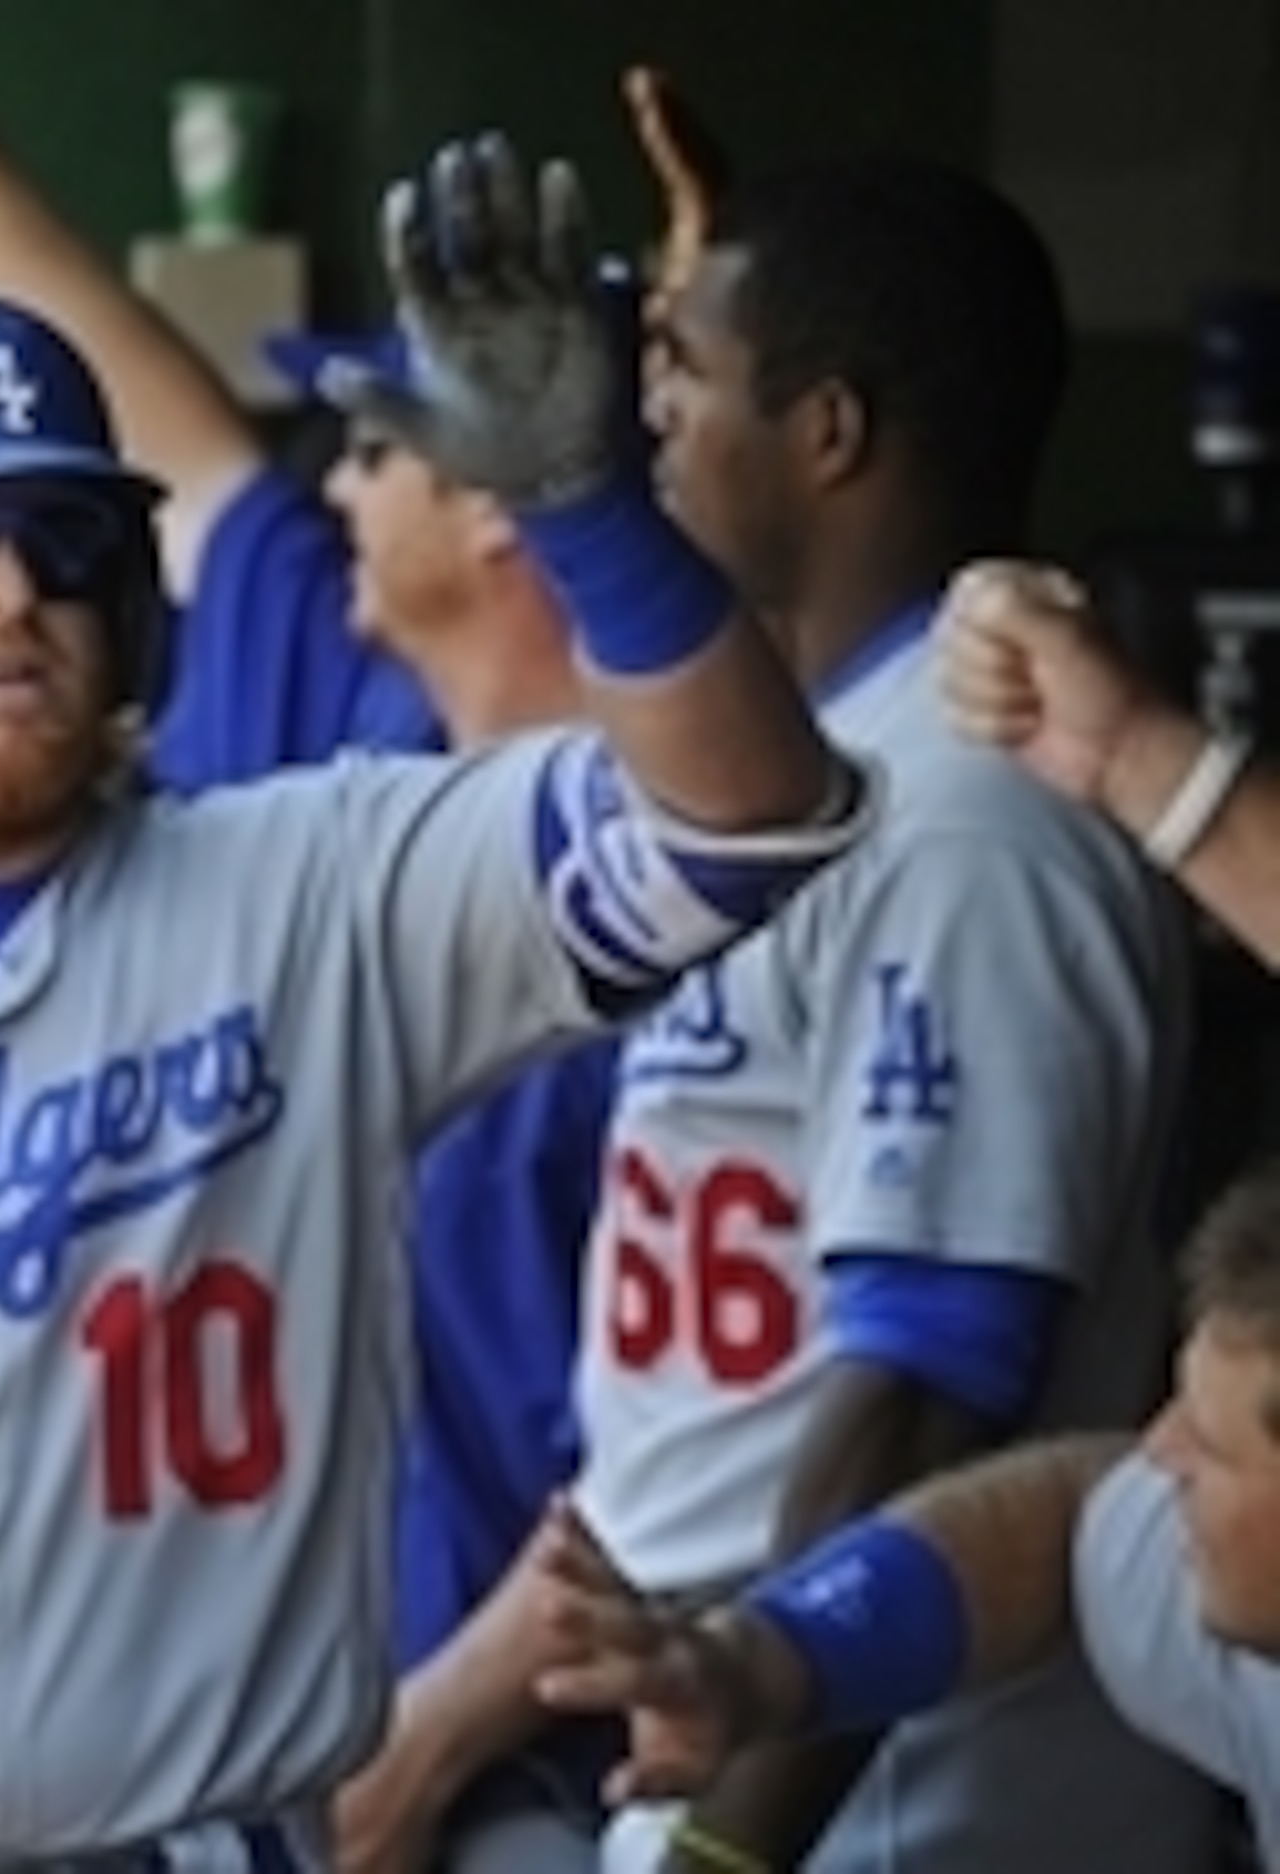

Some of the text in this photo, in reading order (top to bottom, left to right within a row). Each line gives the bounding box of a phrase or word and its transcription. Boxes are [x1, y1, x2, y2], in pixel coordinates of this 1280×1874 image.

[860, 961, 958, 1124] LA
[610, 1146, 800, 1389] 66
[82, 1258, 286, 1524] 10
